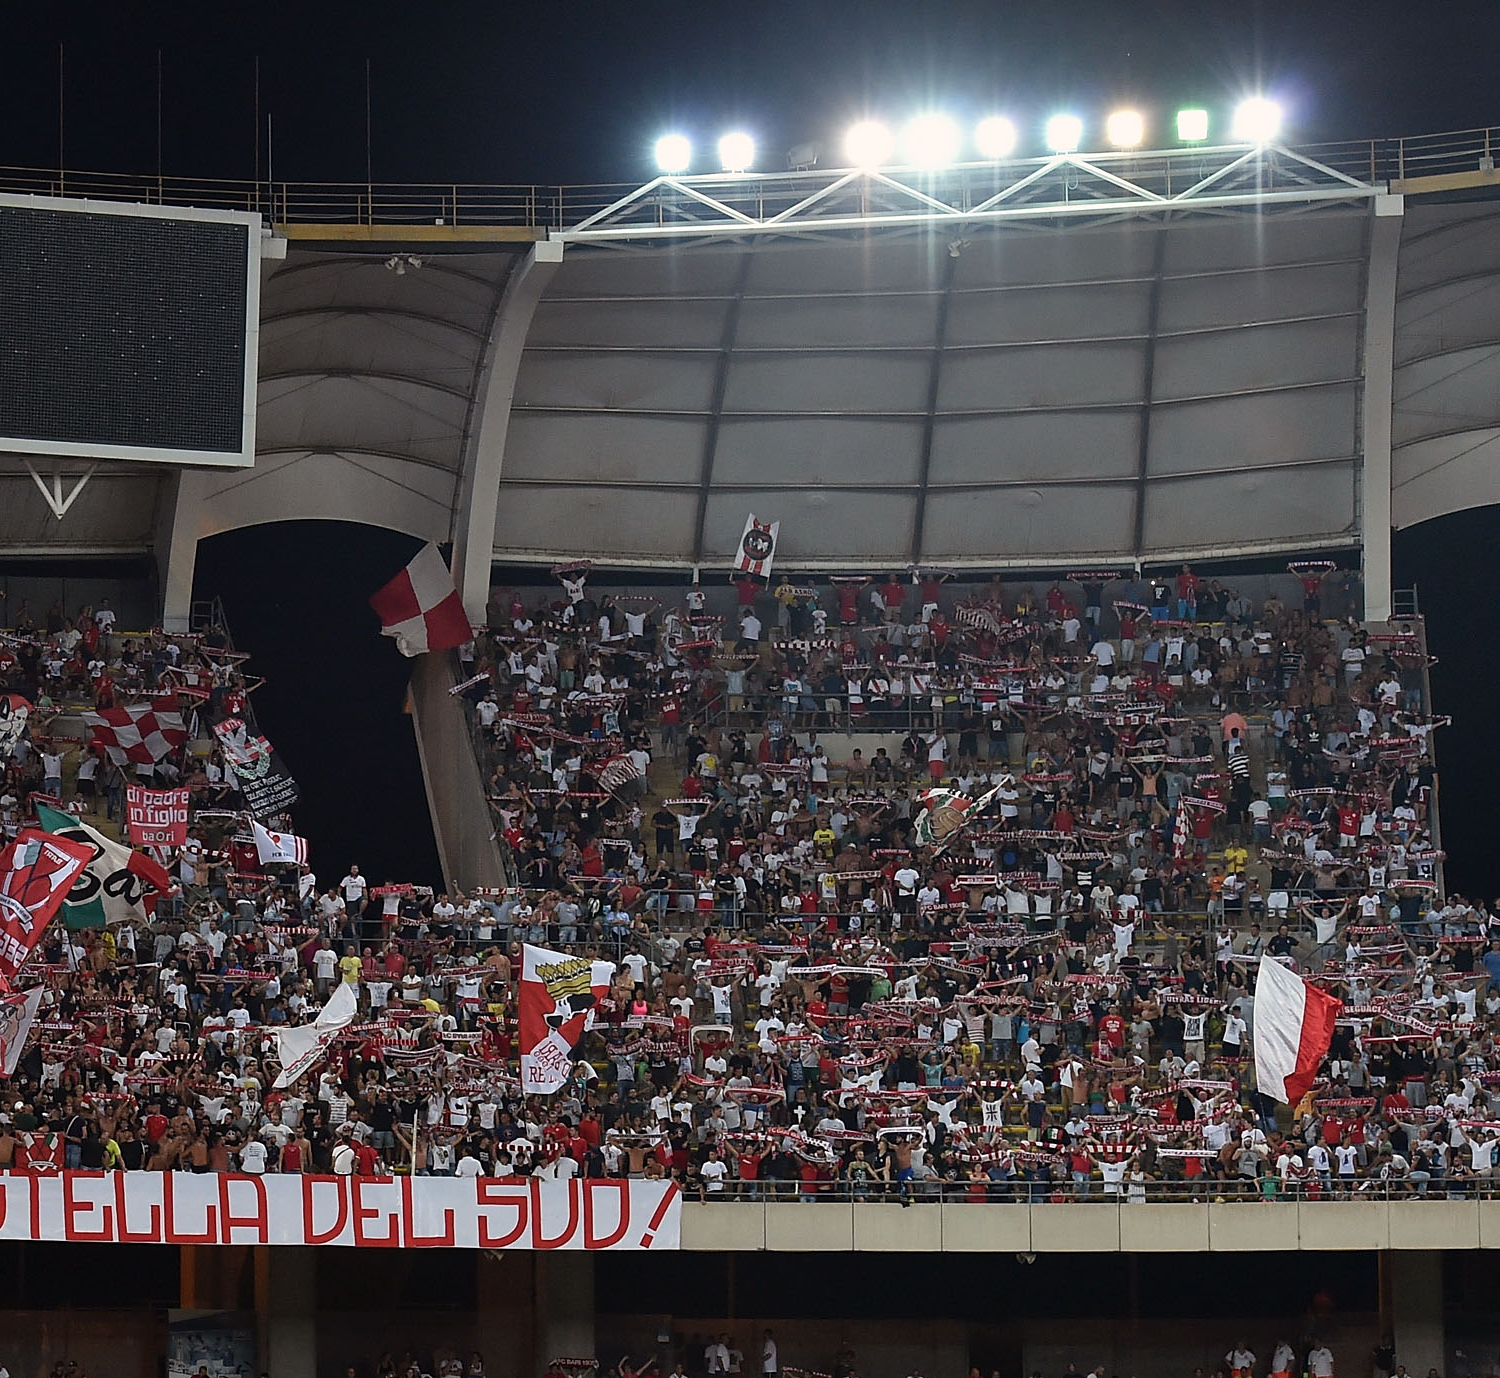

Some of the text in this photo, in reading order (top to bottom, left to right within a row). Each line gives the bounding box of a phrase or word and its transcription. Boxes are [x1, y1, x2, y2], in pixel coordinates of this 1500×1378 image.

[126, 787, 190, 808] di padre
[130, 806, 189, 827] in figlio
[1166, 996, 1195, 1004] ULTRAS
[1344, 1005, 1381, 1013] SEGUACI
[351, 1022, 388, 1032] SEGUACI
[302, 1173, 456, 1249] DEL
